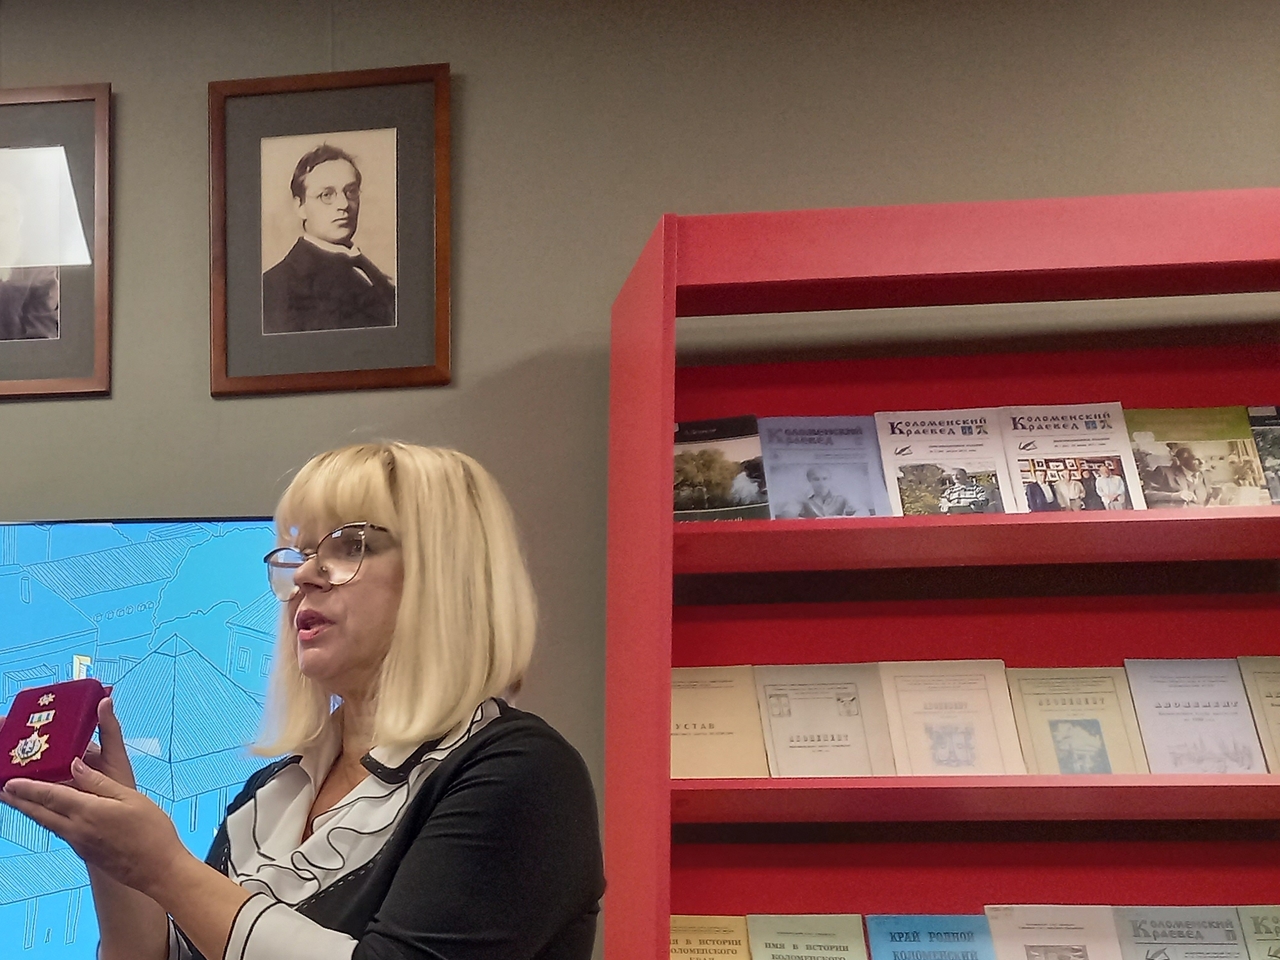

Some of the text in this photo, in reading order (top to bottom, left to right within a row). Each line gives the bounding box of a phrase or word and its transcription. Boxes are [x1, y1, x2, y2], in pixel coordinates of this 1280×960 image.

[889, 930, 975, 942] КРАЙ РОДНОЙ
[670, 947, 738, 955] ОЛОМЕНСКОГО
[805, 944, 850, 952] ИСТОРИИ
[892, 949, 979, 960] КОЛОМЕНСКИЙ
